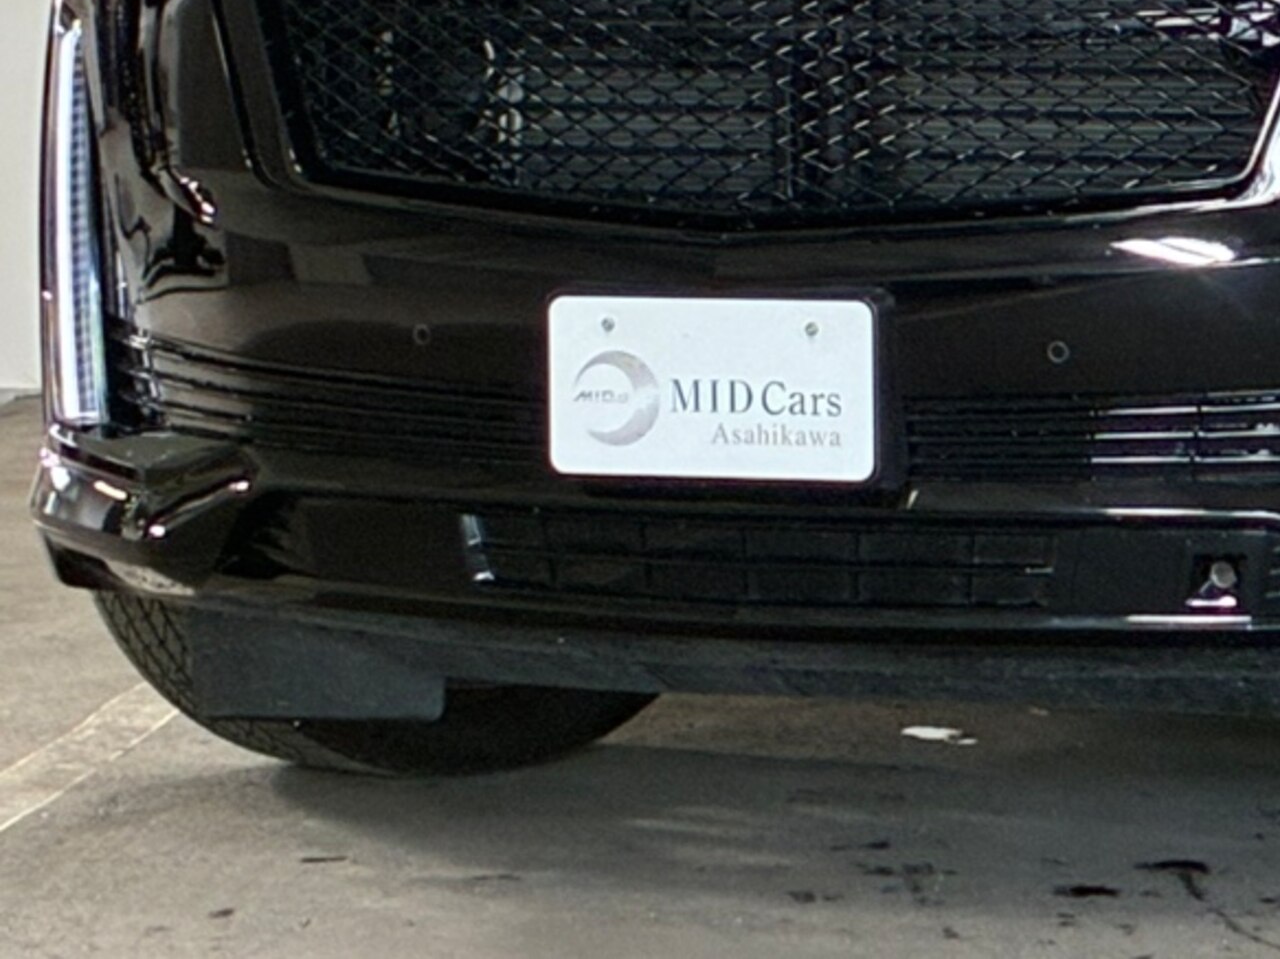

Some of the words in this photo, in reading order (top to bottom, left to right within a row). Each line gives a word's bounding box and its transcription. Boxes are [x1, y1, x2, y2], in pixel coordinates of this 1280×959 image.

[671, 379, 753, 414] MID
[761, 380, 842, 417] Cars
[711, 422, 842, 447] Asahikawa
